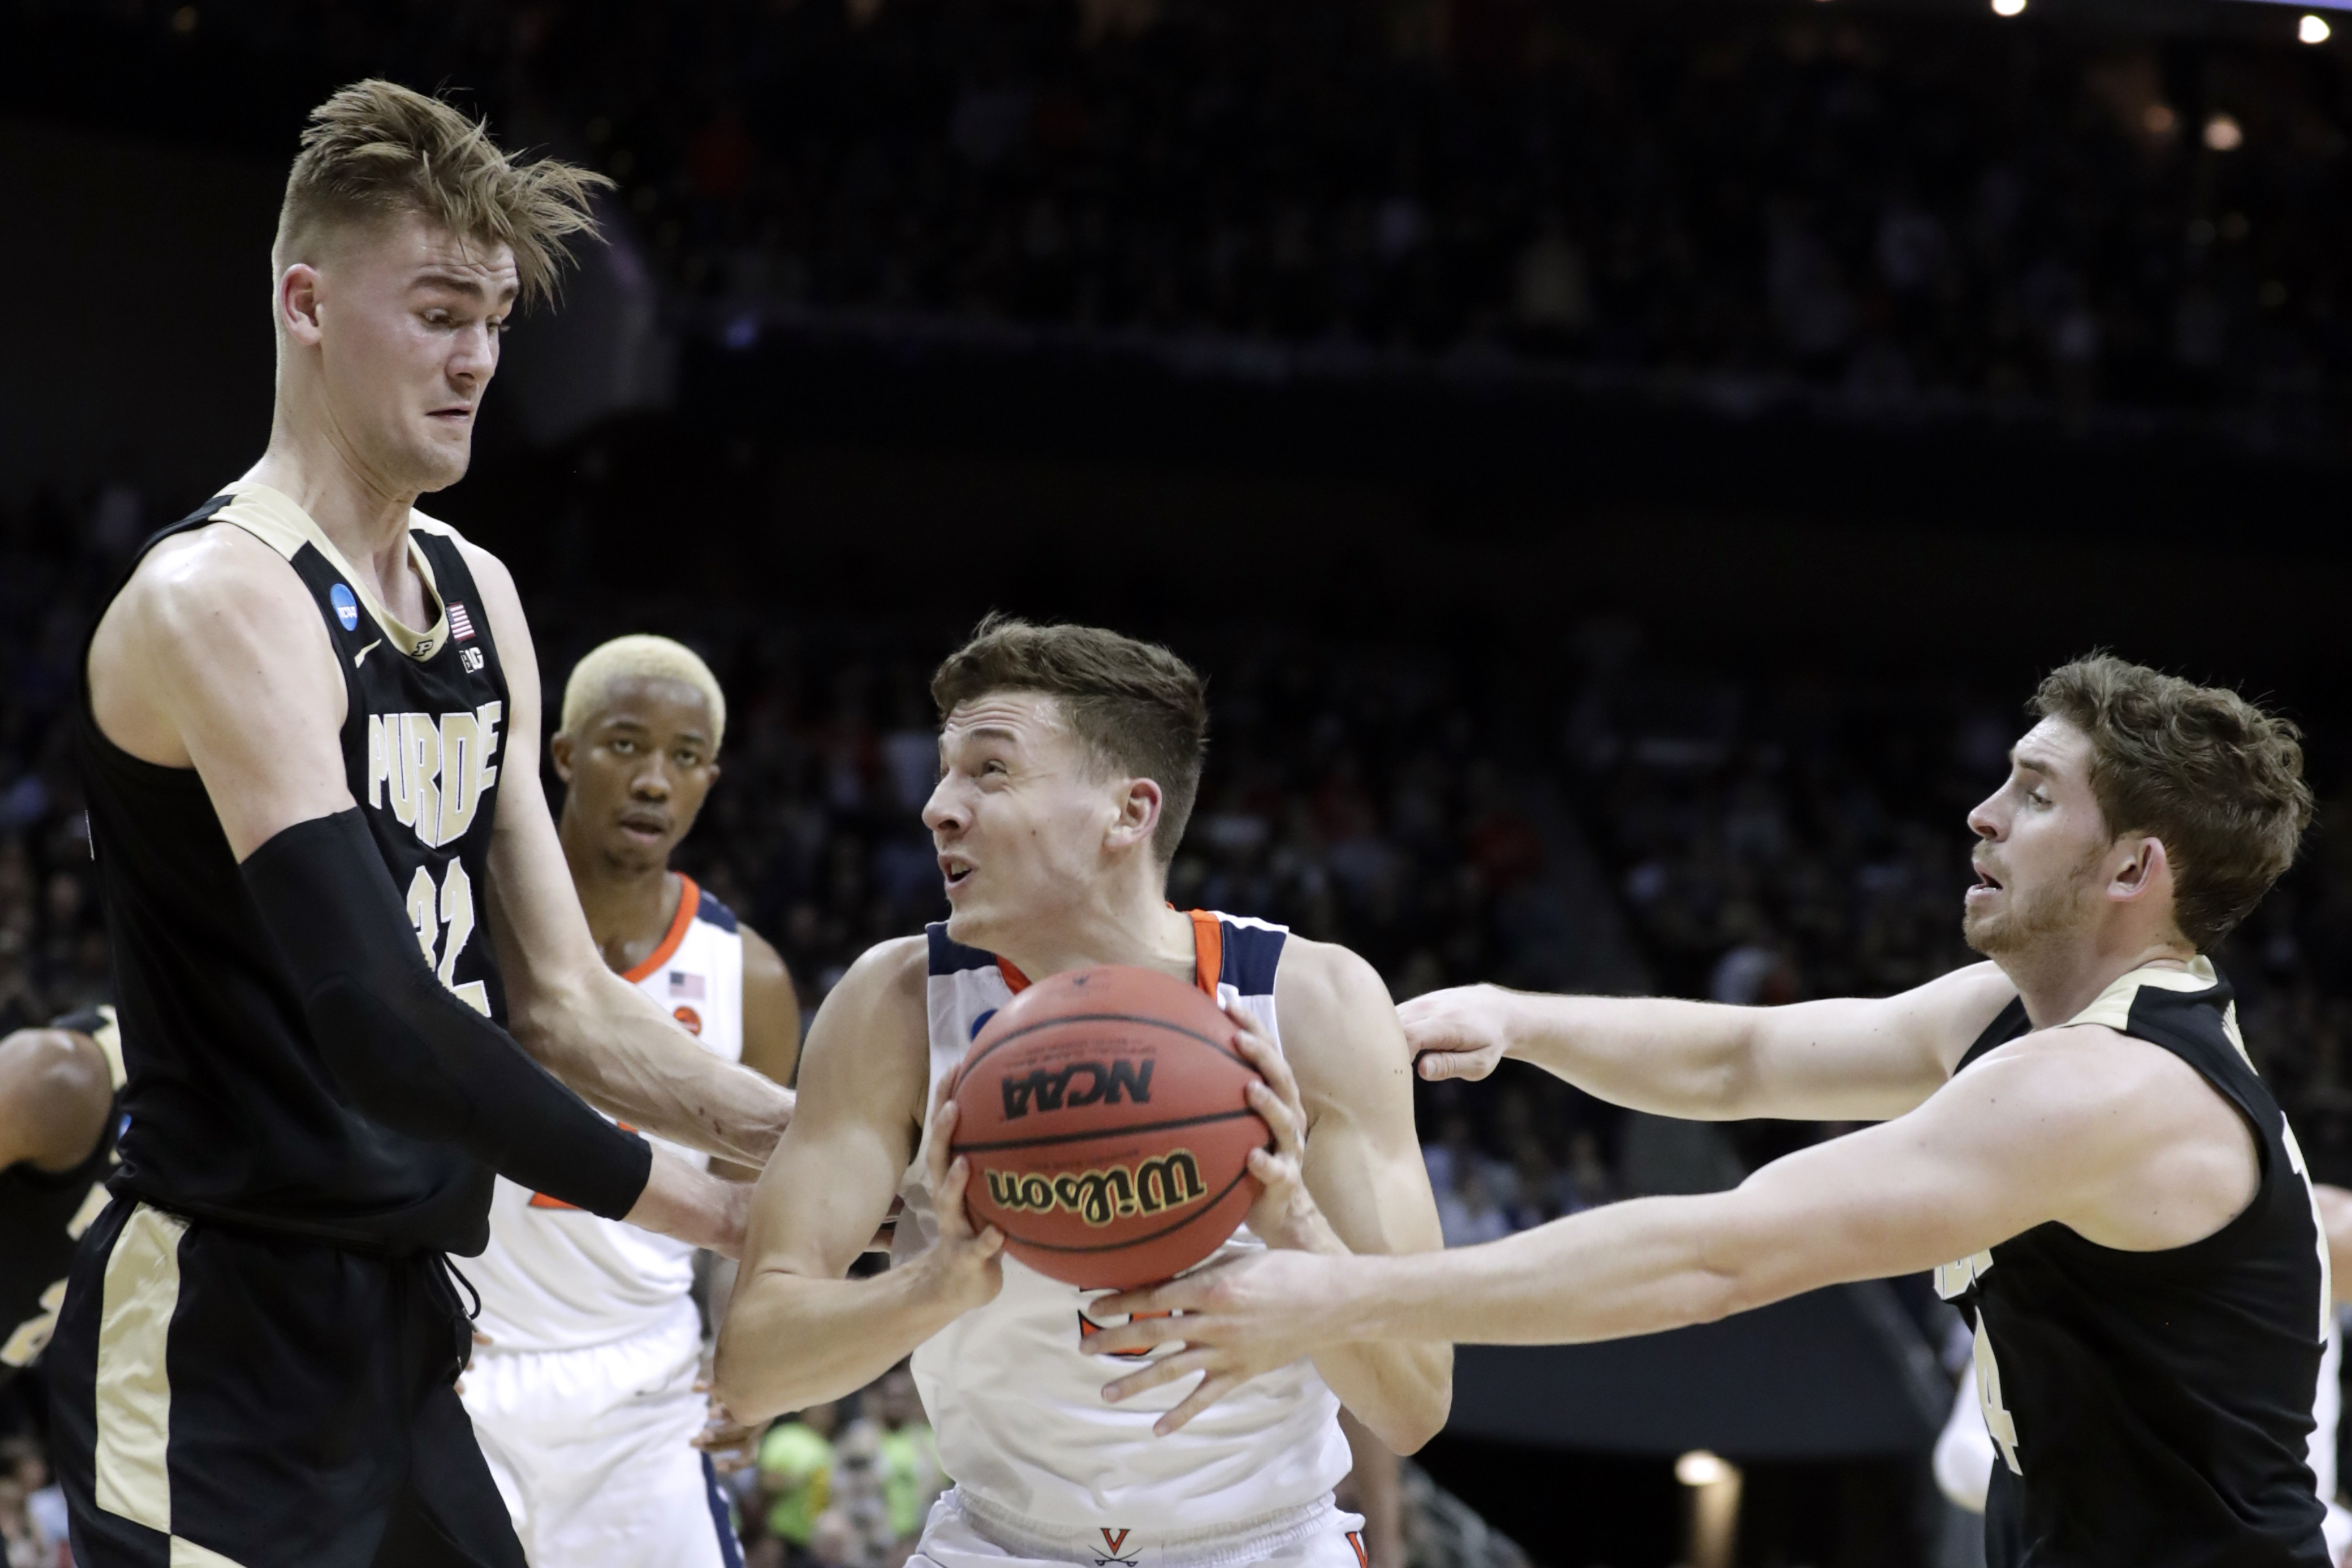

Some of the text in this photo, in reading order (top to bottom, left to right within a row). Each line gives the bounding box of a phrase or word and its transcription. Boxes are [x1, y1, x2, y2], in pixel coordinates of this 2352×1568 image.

[368, 700, 502, 849] PURDE
[407, 856, 492, 1018] 32
[1002, 1059, 1155, 1120] NCAA
[985, 1148, 1208, 1228] Wilson
